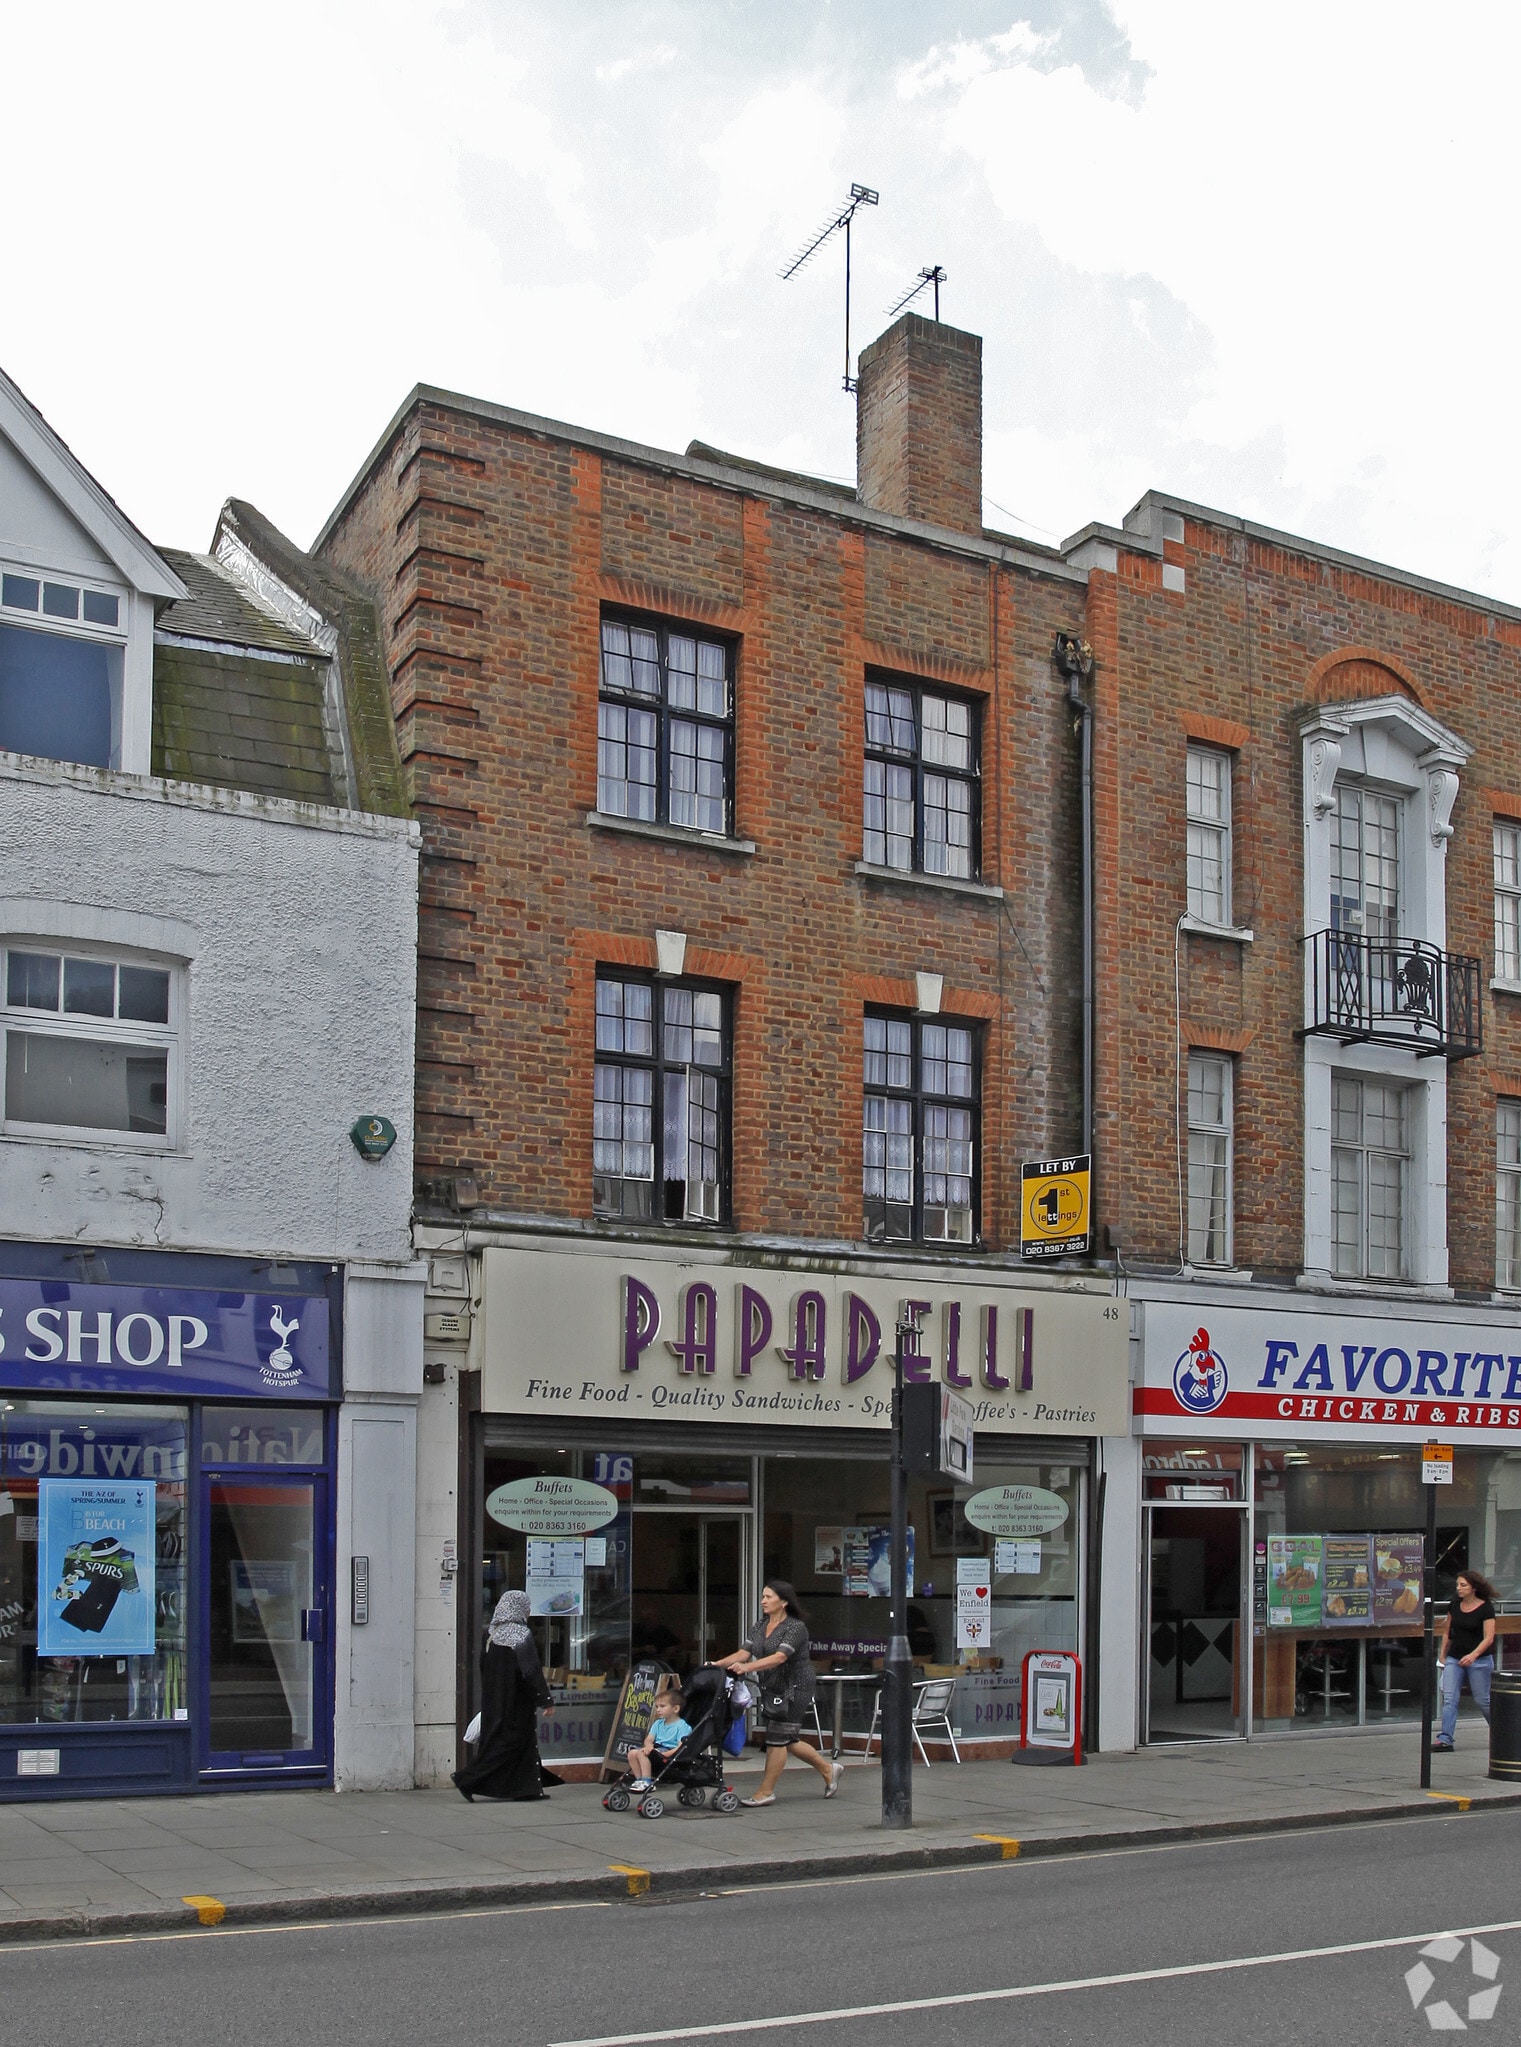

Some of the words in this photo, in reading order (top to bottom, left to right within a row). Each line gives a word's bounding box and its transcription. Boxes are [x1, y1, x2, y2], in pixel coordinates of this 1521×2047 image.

[1040, 1163, 1059, 1174] LET
[1062, 1160, 1077, 1172] BY
[1038, 1210, 1078, 1223] lettings
[1026, 1246, 1043, 1255] 020
[1066, 1241, 1085, 1251] 3222
[1102, 1307, 1119, 1321] 48
[25, 1307, 208, 1367] SHOP
[620, 1274, 1034, 1392] PAPADELLI
[259, 1366, 303, 1379] TOTTENHAM
[262, 1376, 299, 1387] HOTSPUR
[526, 1379, 572, 1399] Fine
[579, 1382, 629, 1402] Food
[652, 1385, 725, 1410] Quality
[732, 1389, 841, 1412] Sandwiches
[1033, 1404, 1096, 1422] Pastries
[1278, 1398, 1420, 1422] CHICKEN
[1430, 1407, 1446, 1422] &
[1456, 1406, 1520, 1425] RIBS
[534, 1480, 573, 1495] Buffets
[498, 1497, 518, 1505] Home
[523, 1498, 543, 1506] Office
[549, 1498, 573, 1506] Special
[1002, 1489, 1033, 1501] Buffets
[569, 1509, 611, 1517] requirements
[85, 1519, 125, 1531] BEACH
[529, 1521, 544, 1530] 020
[545, 1521, 565, 1530] 8363
[567, 1522, 586, 1530] 3160
[1376, 1537, 1399, 1548] Special
[1400, 1536, 1420, 1546] Offers
[85, 1561, 124, 1579] SPURS
[959, 1589, 972, 1597] We
[808, 1640, 828, 1651] Take
[830, 1642, 855, 1653] Away
[857, 1642, 887, 1653] Specia
[975, 1677, 994, 1685] Fine
[997, 1676, 1020, 1684] Food
